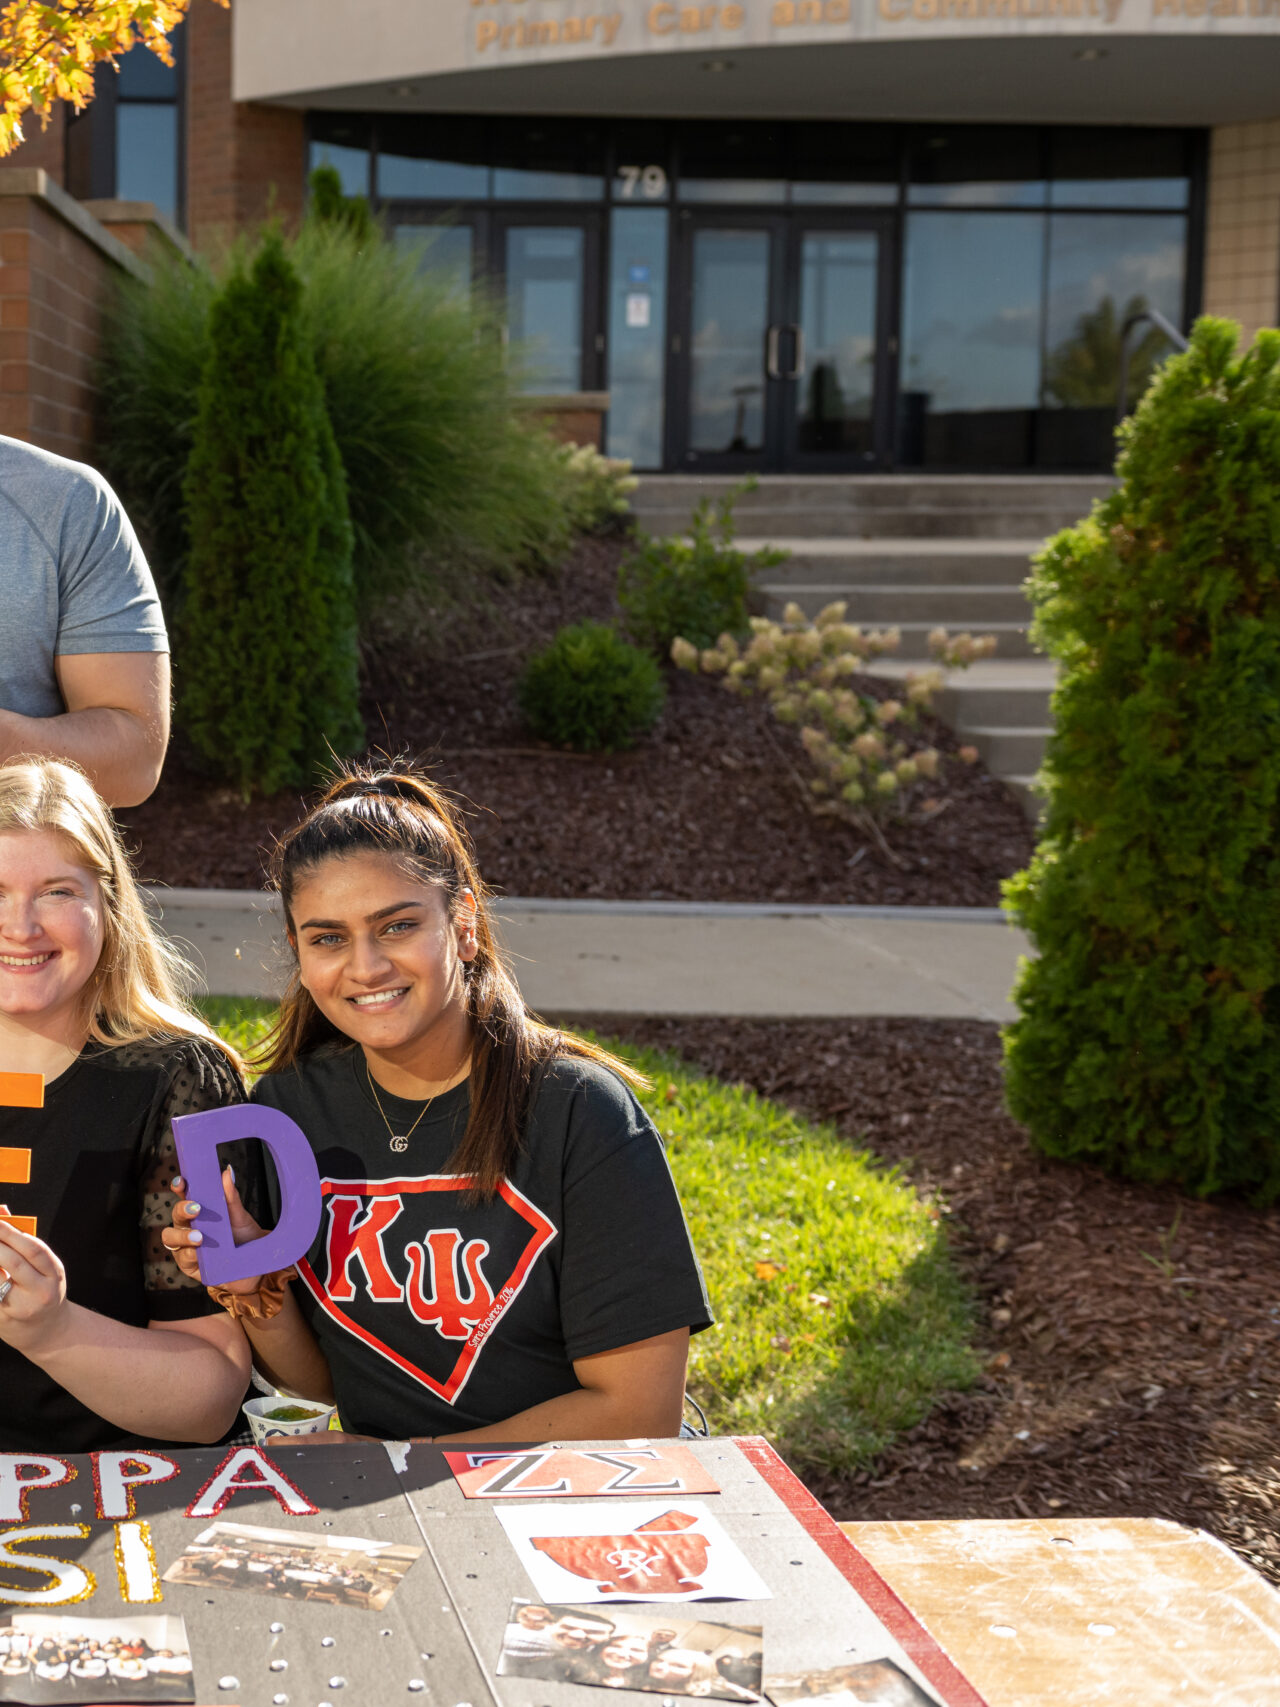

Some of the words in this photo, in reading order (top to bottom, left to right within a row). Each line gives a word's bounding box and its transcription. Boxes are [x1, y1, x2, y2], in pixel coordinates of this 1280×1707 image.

[476, 14, 624, 52] Primary
[647, 2, 745, 36] Care
[771, 0, 851, 27] and
[619, 165, 667, 199] 79
[172, 1103, 323, 1286] D
[477, 1303, 504, 1335] Province
